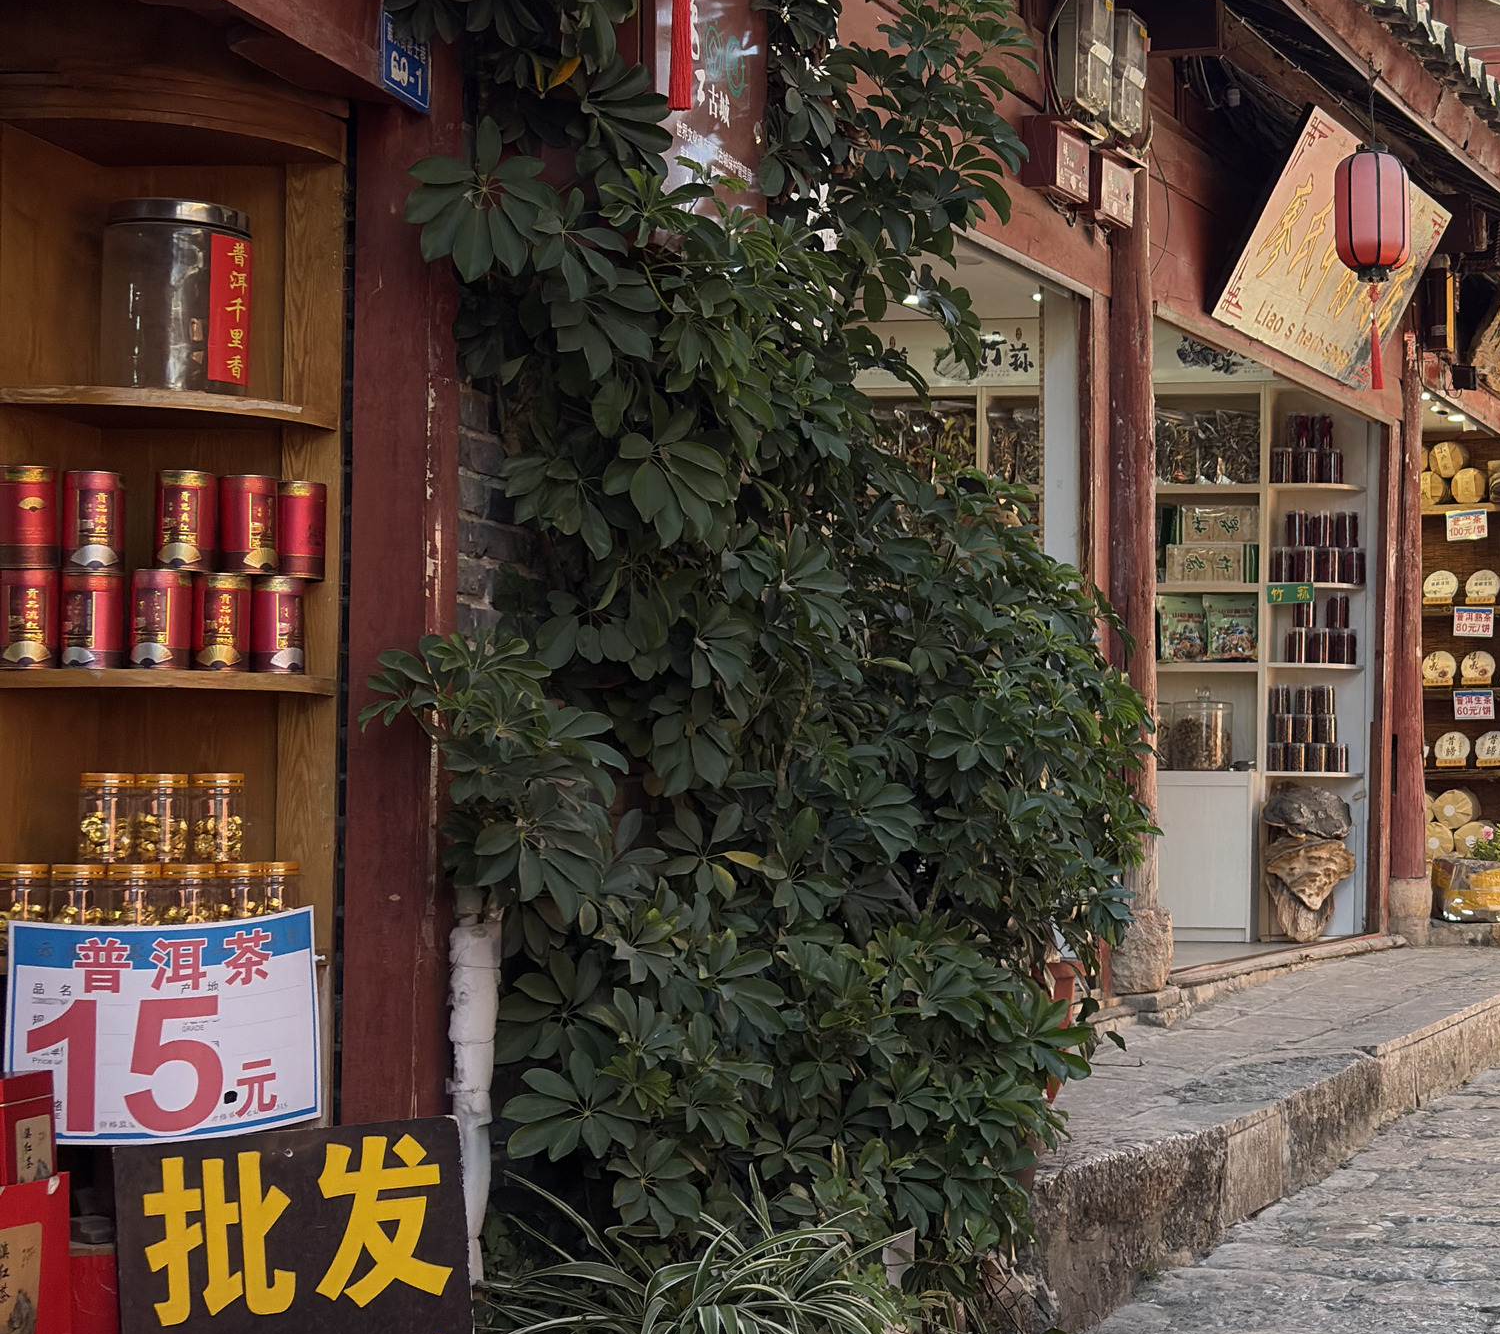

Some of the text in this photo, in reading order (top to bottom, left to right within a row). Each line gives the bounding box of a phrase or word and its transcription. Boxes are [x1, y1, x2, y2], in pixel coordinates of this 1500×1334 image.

[225, 241, 249, 379] 普洱千里香
[1254, 300, 1284, 335] Liao
[1456, 623, 1491, 633] 80元/饼
[1456, 695, 1492, 705] 普洱生茶
[1456, 705, 1492, 716] 60元/饼
[73, 927, 273, 994] 普洱茶
[142, 1133, 453, 1327] 批发
